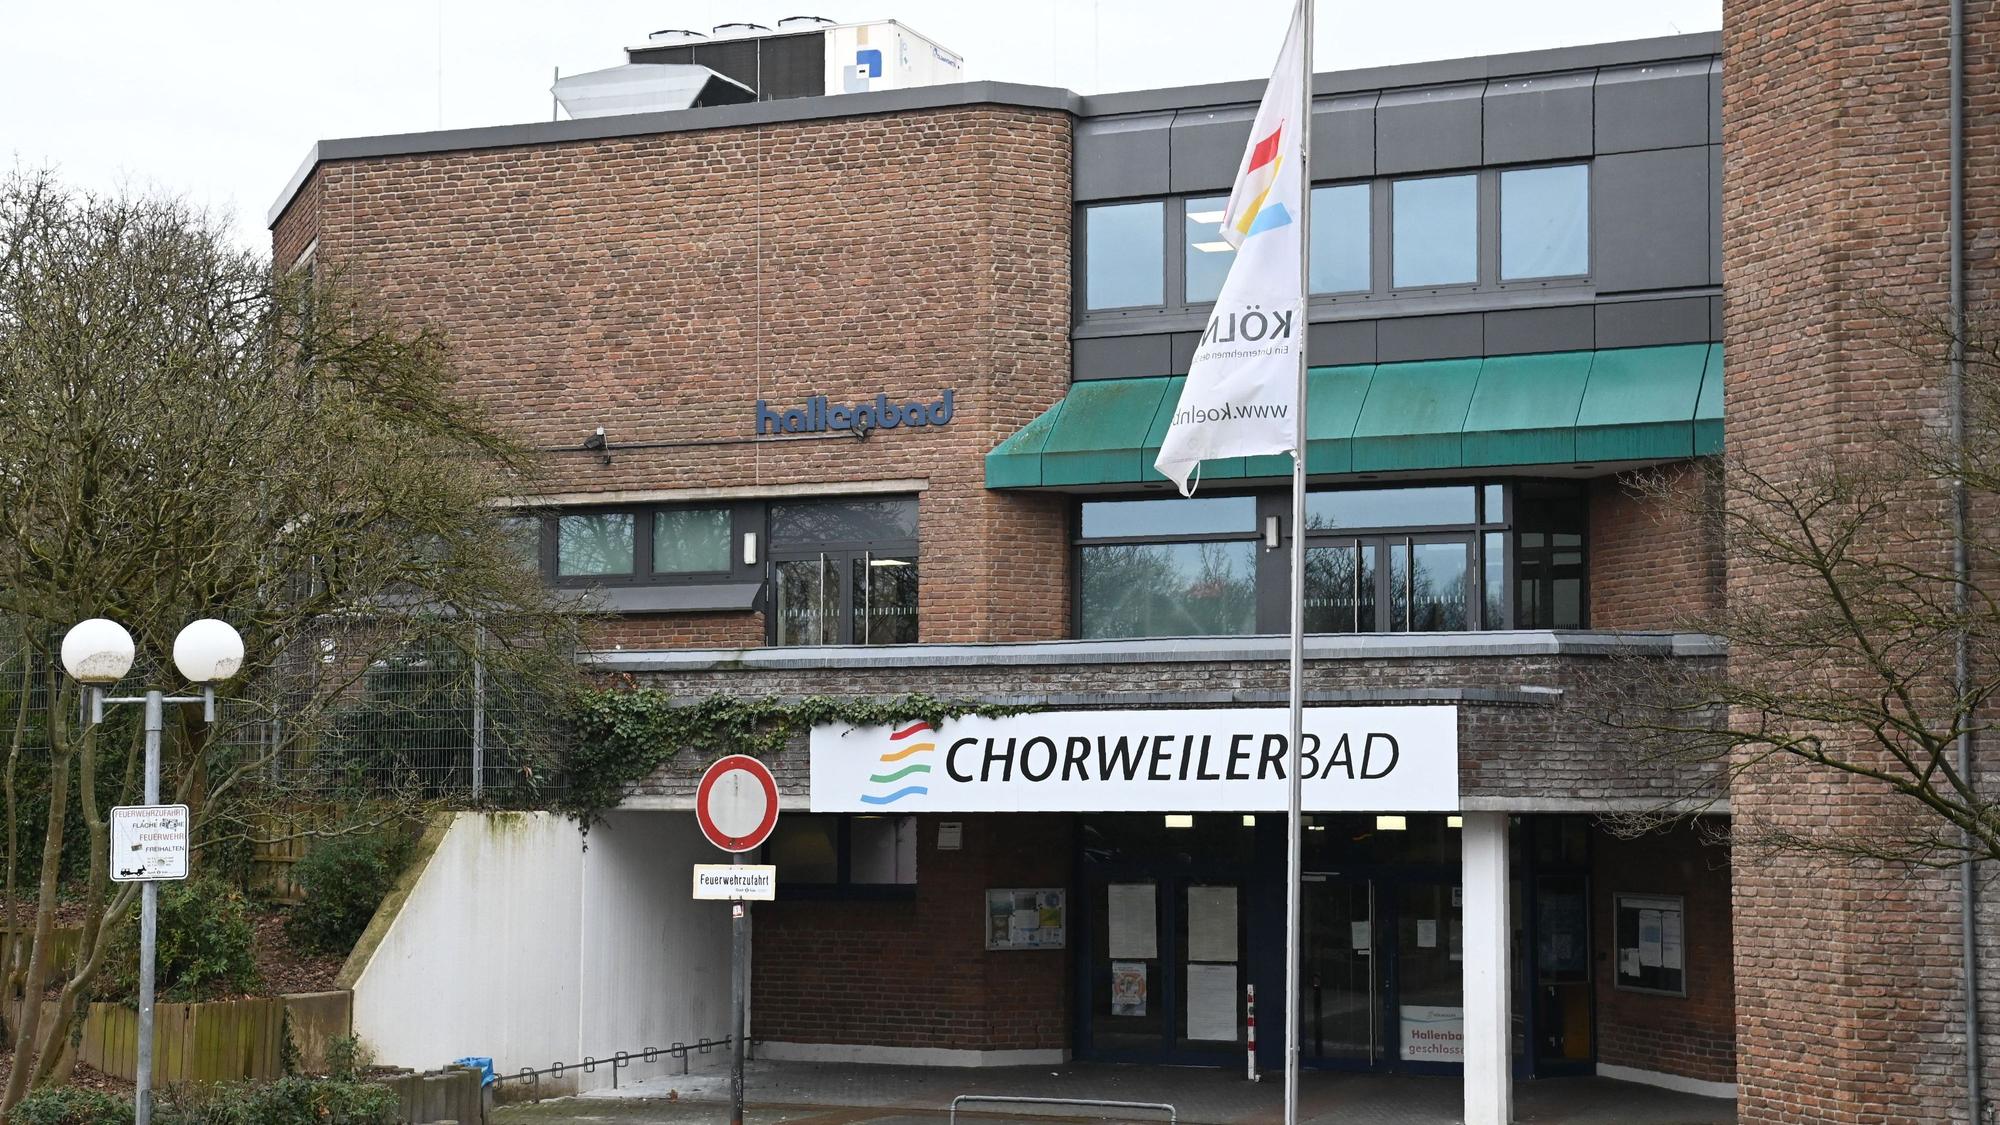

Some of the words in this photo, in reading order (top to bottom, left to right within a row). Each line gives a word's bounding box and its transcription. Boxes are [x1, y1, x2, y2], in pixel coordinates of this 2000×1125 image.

[757, 389, 954, 434] hallenbad
[945, 732, 1400, 783] CHORWEILERBAD
[115, 809, 184, 818] FEUERWEHRZUFAHRT
[139, 833, 184, 841] FEUERWEHR
[145, 845, 185, 853] FREIHALTEN
[700, 873, 769, 886] Feuerwehrzufahrt
[1411, 1030, 1464, 1041] Hallenba
